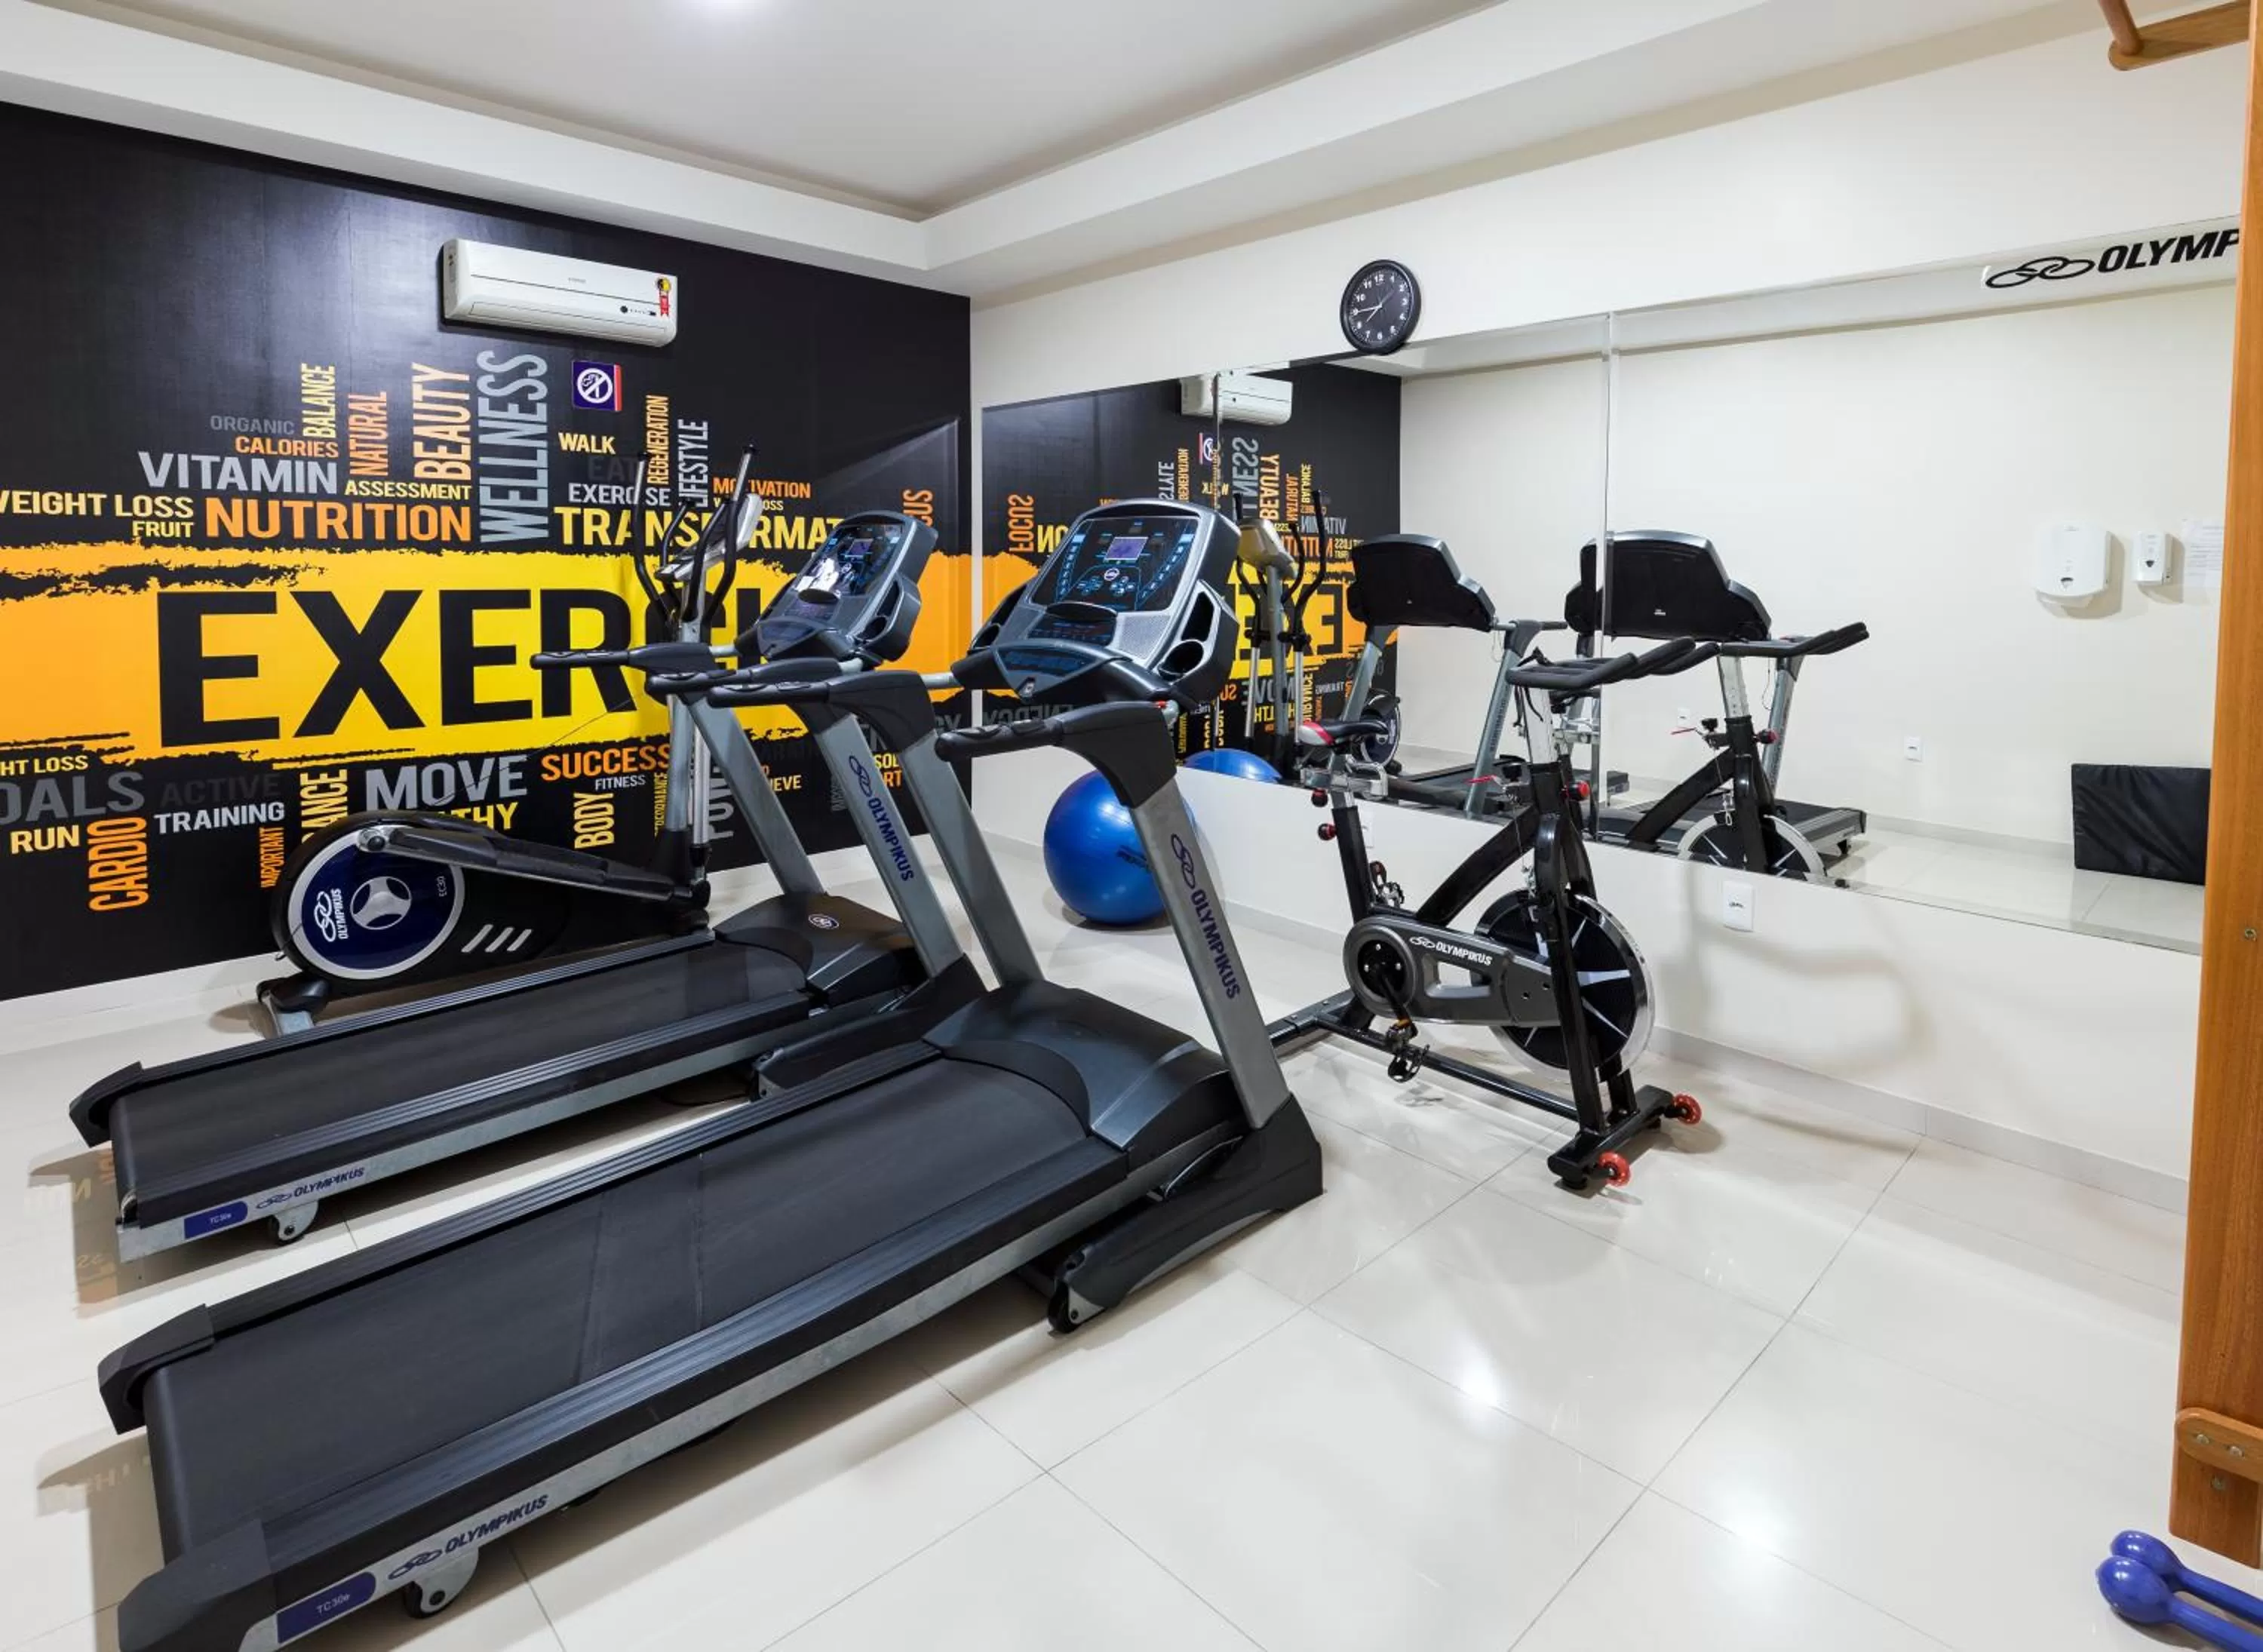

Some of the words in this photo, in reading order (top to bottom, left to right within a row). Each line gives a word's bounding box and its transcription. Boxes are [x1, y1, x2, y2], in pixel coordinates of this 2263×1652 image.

[301, 363, 336, 438] BALANCE
[210, 415, 295, 435] ORGANIC
[349, 391, 388, 476] NATURAL
[412, 362, 471, 481] BEAUTY
[646, 395, 669, 485] REGENERATION
[235, 436, 339, 458] CALORIES
[477, 350, 549, 544] WELLNESS
[558, 432, 616, 455] WALK
[677, 419, 708, 508] LIFESTYLE
[138, 451, 337, 494] VITAMIN
[345, 480, 471, 500] ASSESSMENT
[714, 477, 811, 499] MOIVATION
[115, 494, 194, 518] LOSS
[568, 482, 671, 507] EXERCSE
[132, 520, 195, 538] FRUIT
[205, 497, 471, 542] NUTRITION
[33, 754, 89, 774] LOSS
[541, 743, 670, 781] SUCCESS
[160, 773, 281, 808] ACTIVE
[366, 754, 528, 812] MOVE
[595, 775, 646, 791] FITNESS
[153, 802, 285, 834] TRAINING
[573, 792, 615, 849] BODY
[10, 824, 80, 855] RUN
[259, 827, 284, 888] IMPORTANT
[866, 796, 914, 882] OLYMPIKUS
[87, 816, 148, 911] CARDIO
[330, 888, 349, 940] OLYMPIKUS
[1190, 889, 1241, 1000] OLYMPIKUS
[1435, 940, 1493, 966] OLYMPIKUS
[293, 1167, 365, 1199] OLYMPIKUS
[444, 1494, 549, 1554] OLYMPIKUS
